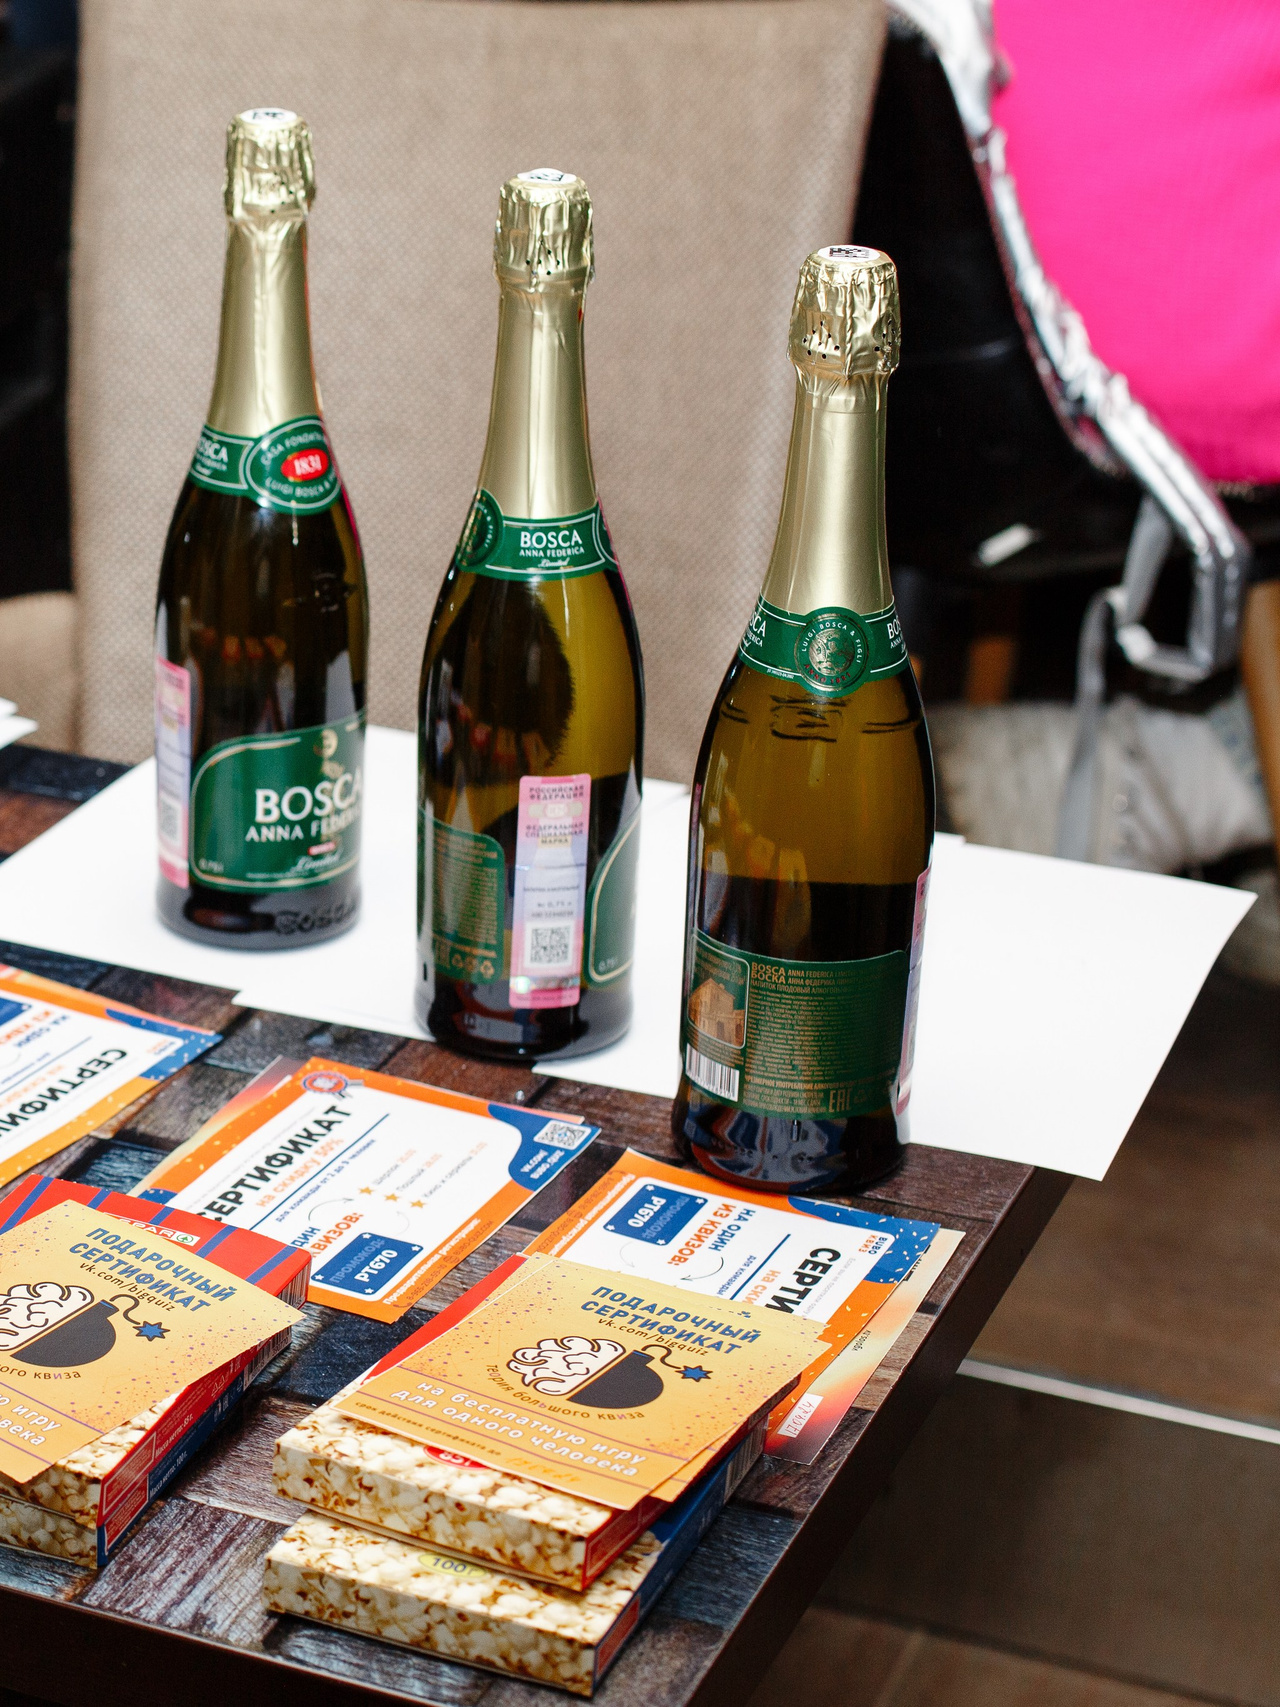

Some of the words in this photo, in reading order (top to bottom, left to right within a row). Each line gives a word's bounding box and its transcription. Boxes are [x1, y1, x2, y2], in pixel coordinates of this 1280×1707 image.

[519, 549, 544, 558] ANNA
[546, 546, 585, 558] FEDERICA
[520, 529, 583, 549] BOSCA
[802, 629, 817, 652] LUIGI
[820, 622, 848, 631] BOSCA
[855, 638, 863, 664] FIGLI
[255, 766, 363, 824] BOSCA
[245, 824, 305, 842] ANNA
[750, 979, 776, 991] НАПИТОК
[776, 984, 811, 994] ПЛОДОВЫЙ
[751, 971, 786, 985] БОСКА
[787, 977, 805, 986] АННА
[805, 978, 836, 986] ФЕДЕРИКА
[752, 962, 785, 976] BOSCA
[787, 969, 805, 977] ANNA
[806, 970, 834, 978] FEDERICA
[272, 1156, 322, 1194] скидку
[712, 1202, 738, 1219] ИЗ
[732, 1207, 757, 1224] НА
[667, 1219, 723, 1267] КВИЗОВ:
[708, 1222, 743, 1253] ОДИН
[858, 1233, 879, 1254] КВИЗ
[867, 1236, 888, 1255] BUBO
[69, 1242, 212, 1313] СЕРТИФИКАТ
[86, 1227, 238, 1302] ПОДАРОЧНЫЙ
[328, 1238, 386, 1285] ПРОМОКОД:
[742, 1254, 758, 1270] для
[766, 1268, 782, 1285] на
[79, 1262, 177, 1312] vk.com/bigquiz
[580, 1300, 742, 1355] СЕРТИФИКАТ
[590, 1286, 762, 1344] ПОДАРОЧНЫЙ
[597, 1317, 709, 1357] vk.com/bigquiz
[33, 1370, 83, 1381] квиза
[485, 1362, 512, 1394] теория
[512, 1389, 591, 1420] большого
[597, 1411, 646, 1422] квиза
[11, 1402, 63, 1434] игру
[355, 1400, 378, 1415] срок
[378, 1408, 423, 1429] действия
[424, 1422, 488, 1452] сертификата
[487, 1448, 502, 1457] до
[390, 1388, 438, 1410] для
[442, 1404, 525, 1440] одного
[529, 1433, 640, 1477] человека
[416, 1381, 445, 1397] на
[449, 1391, 586, 1446] бесплатную
[590, 1439, 647, 1466] игру
